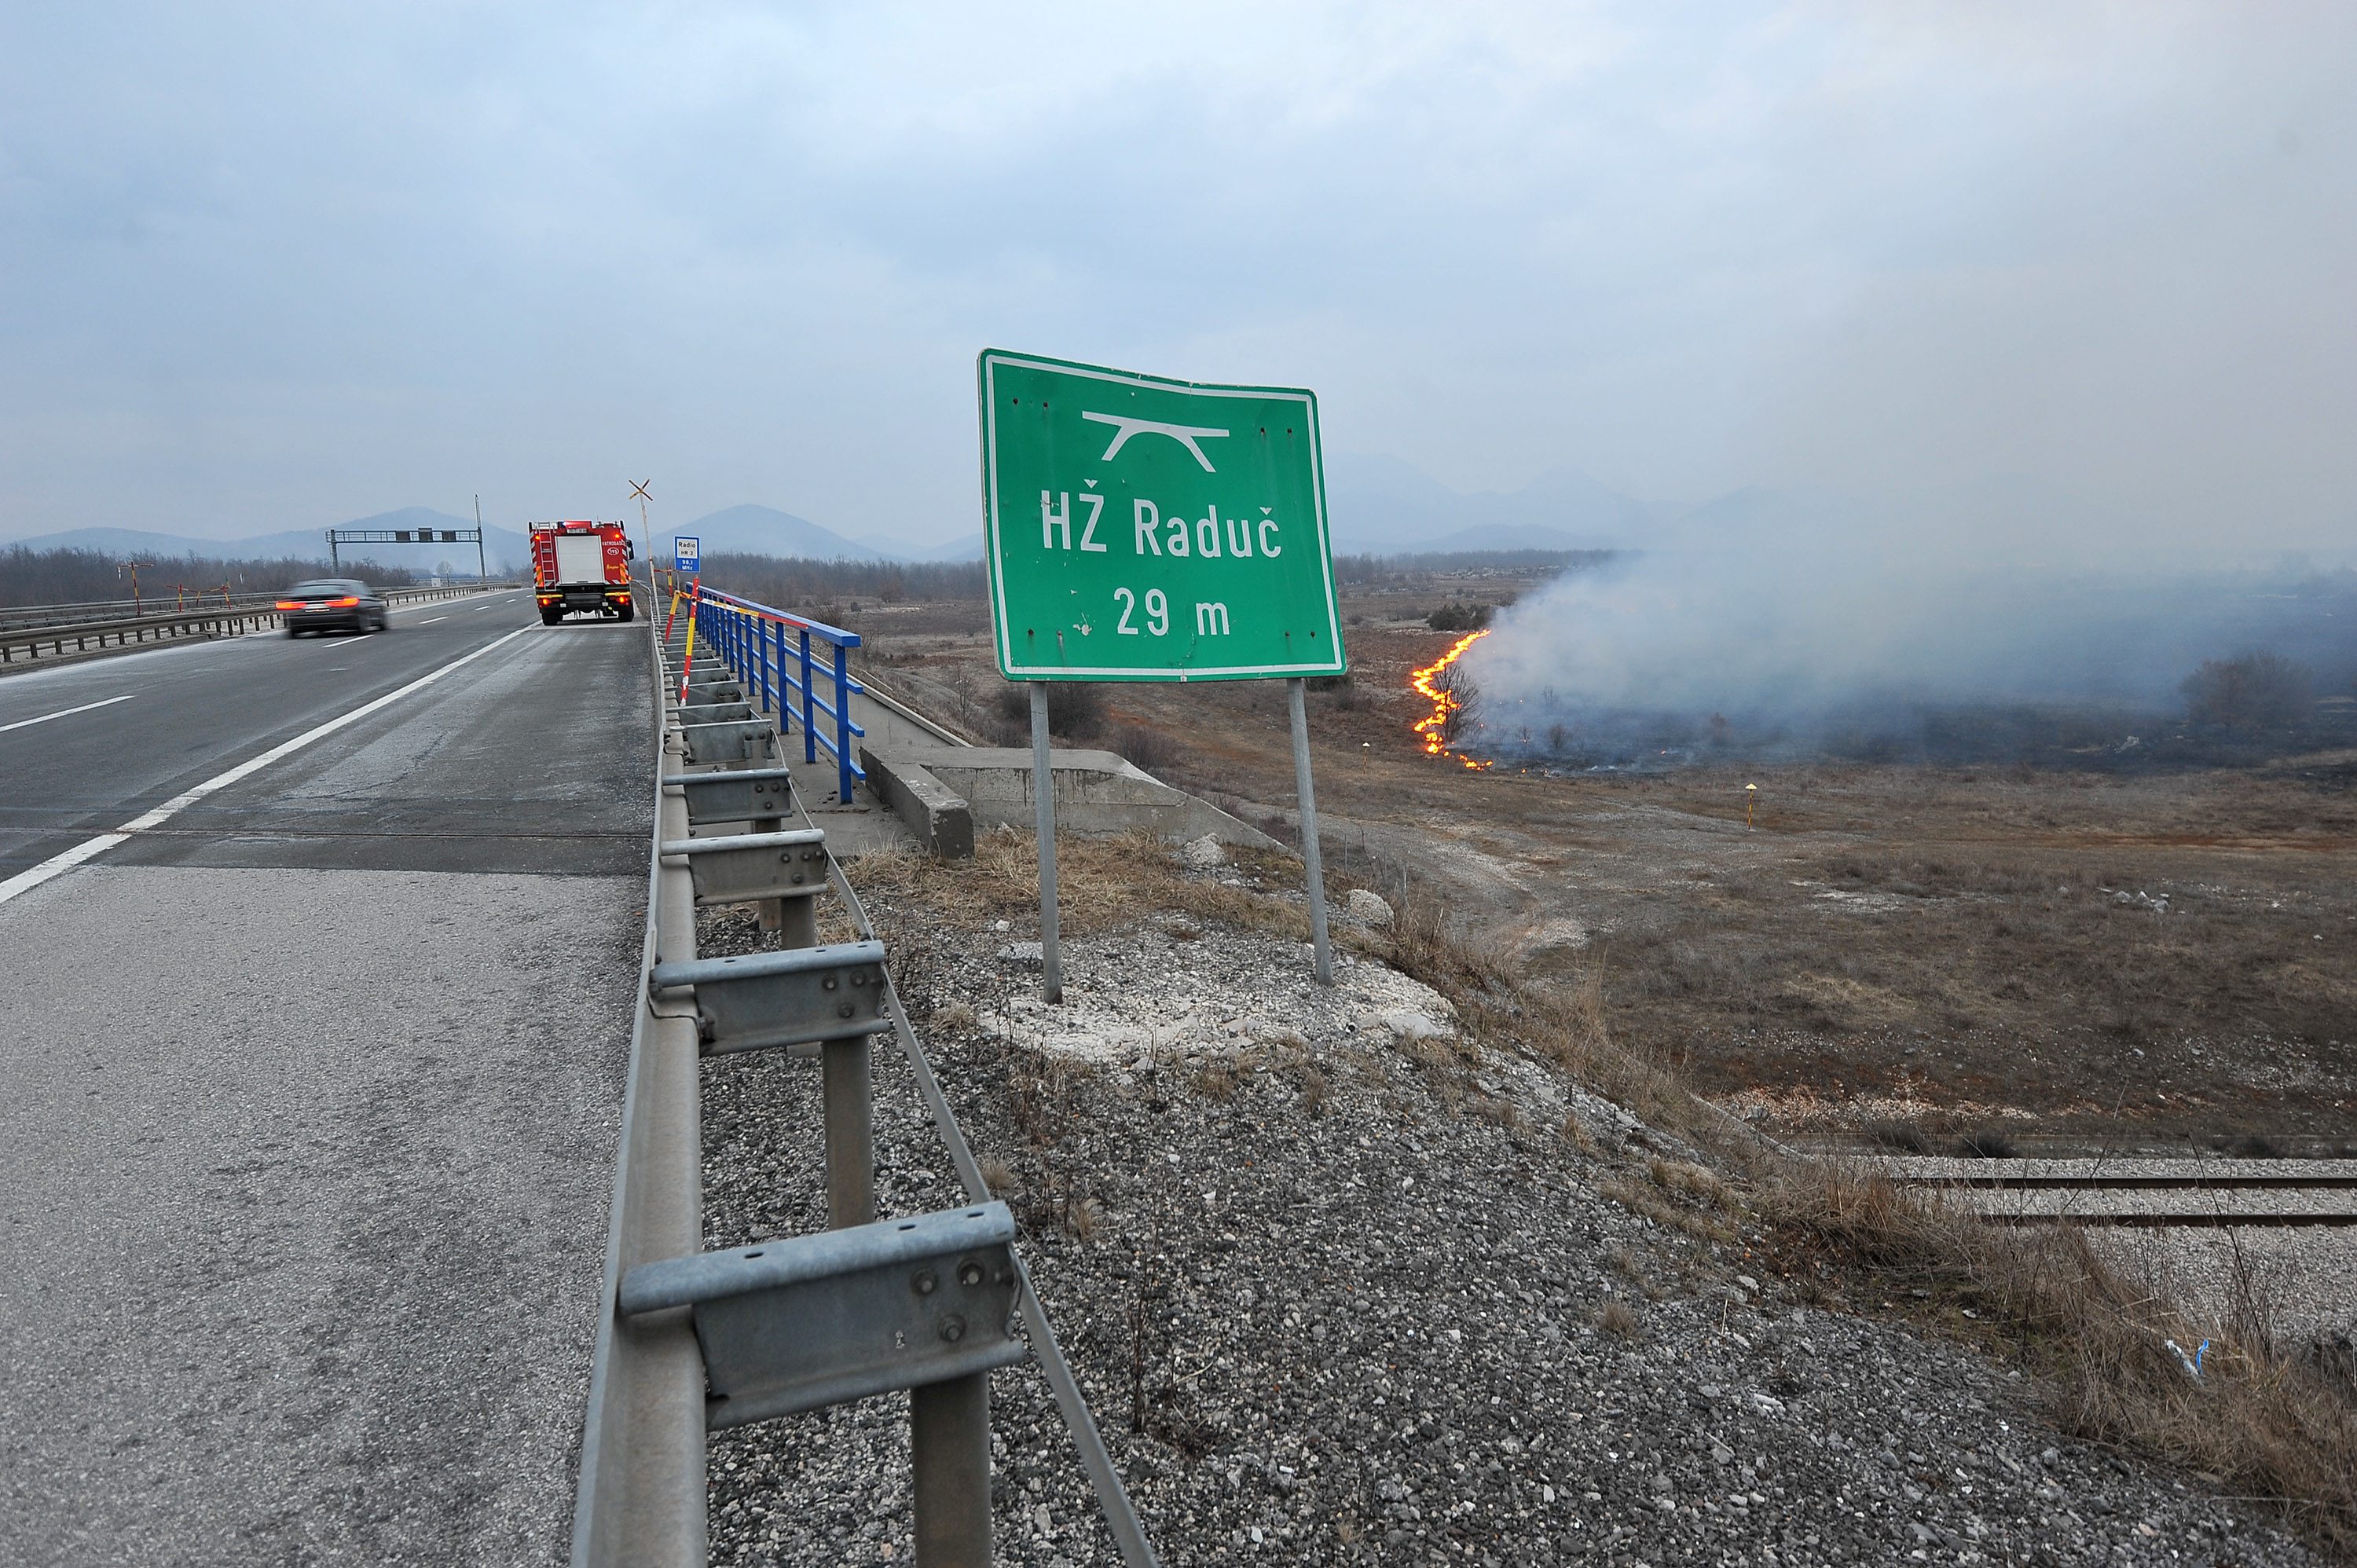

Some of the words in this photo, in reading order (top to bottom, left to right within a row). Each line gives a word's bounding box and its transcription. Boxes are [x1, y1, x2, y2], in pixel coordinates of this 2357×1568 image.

[1041, 478, 1107, 552] HŽ
[1134, 498, 1282, 559] Raduč
[1113, 587, 1170, 637] 29
[1196, 602, 1230, 636] m
